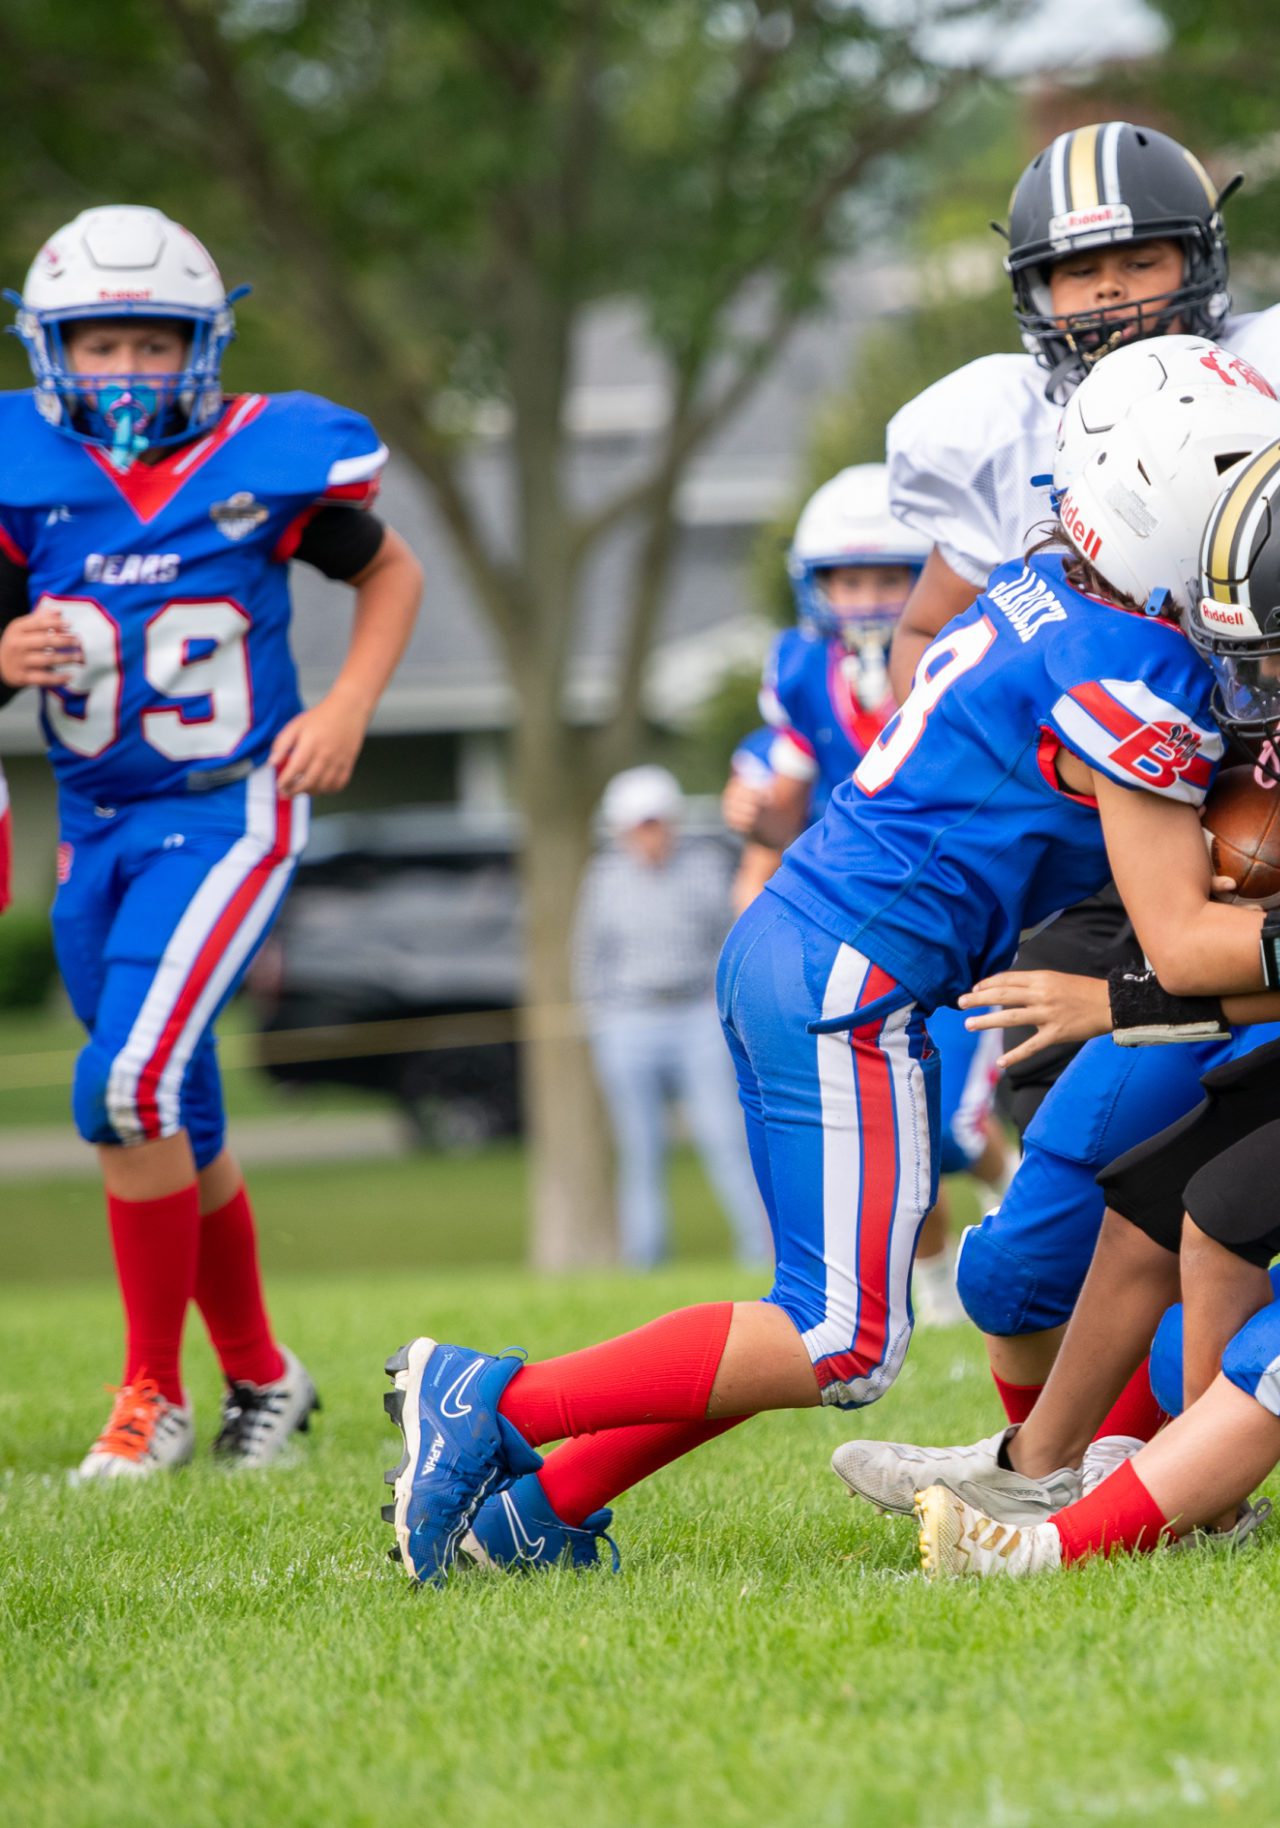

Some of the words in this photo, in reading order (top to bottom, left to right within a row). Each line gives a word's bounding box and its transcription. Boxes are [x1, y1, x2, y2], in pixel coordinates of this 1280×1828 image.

[1060, 496, 1103, 561] ddell
[84, 553, 181, 585] BEARS
[1202, 604, 1244, 625] Riddell
[34, 593, 254, 763] 99
[852, 613, 998, 798] 8
[422, 1432, 446, 1476] ALPHA
